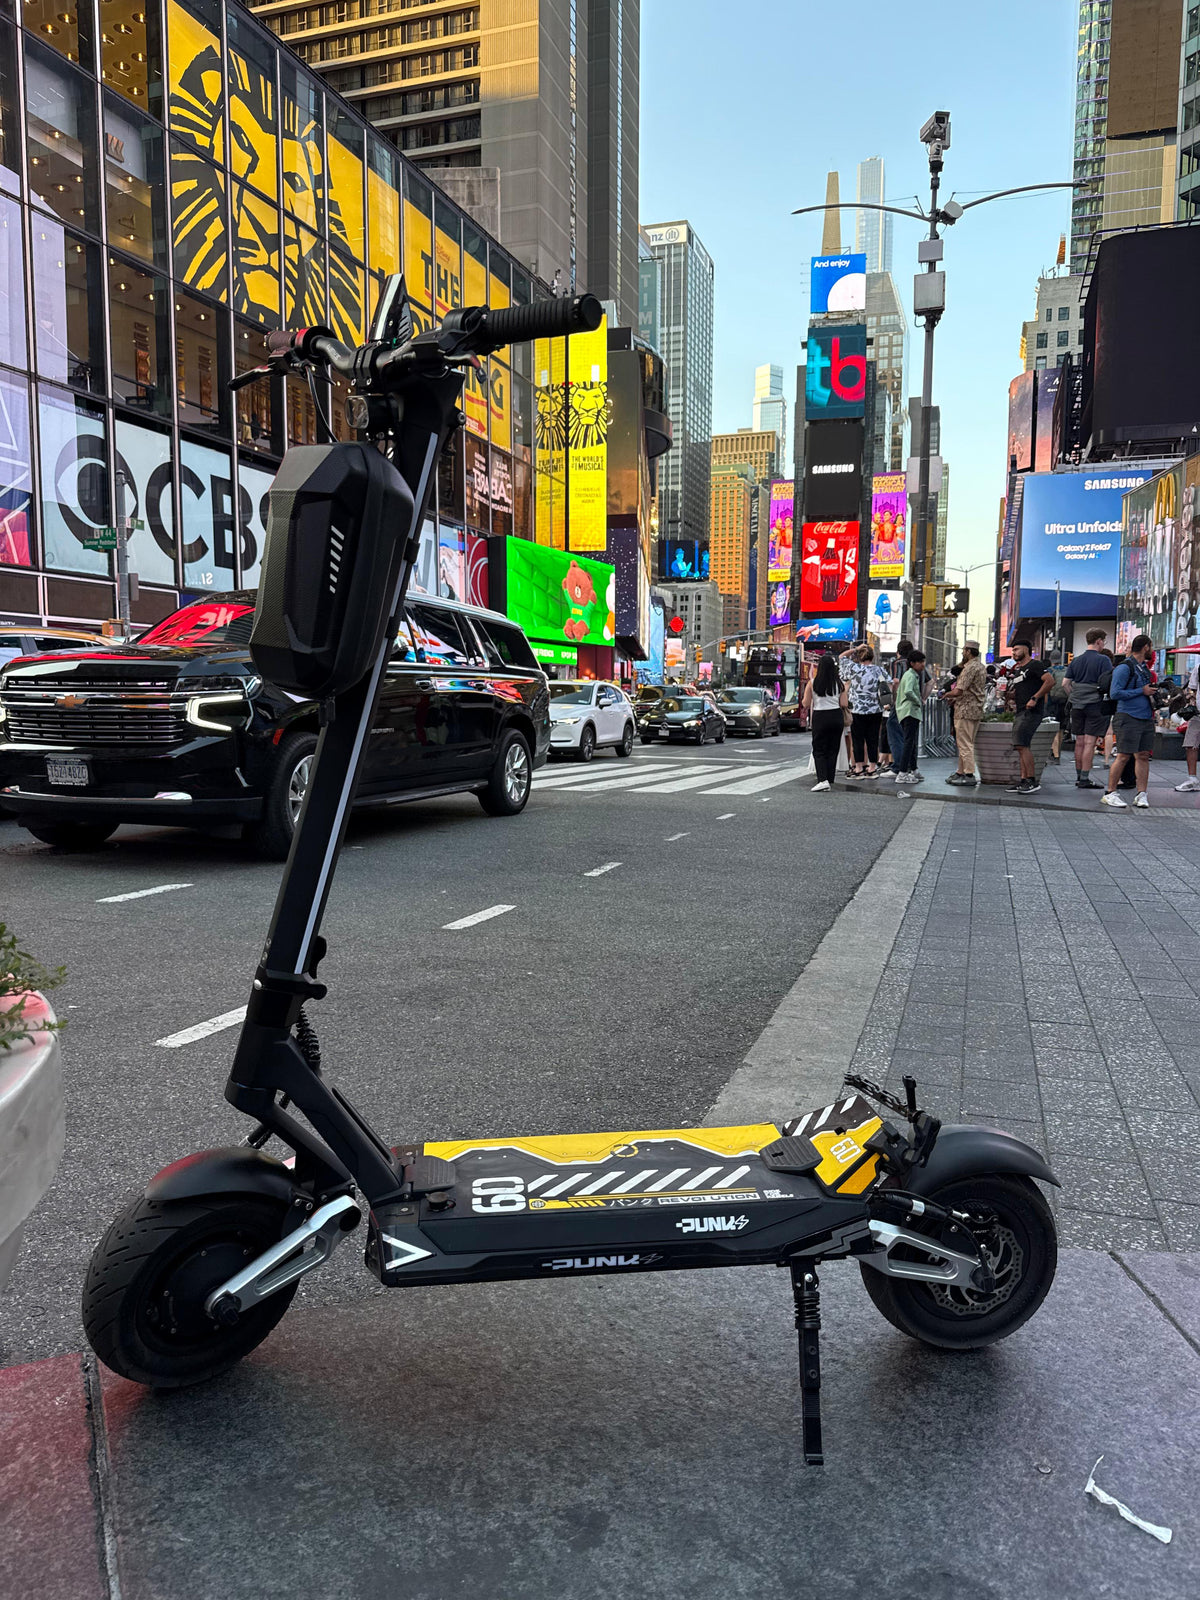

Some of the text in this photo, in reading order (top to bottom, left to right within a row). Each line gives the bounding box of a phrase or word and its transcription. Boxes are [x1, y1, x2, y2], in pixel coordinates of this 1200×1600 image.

[814, 259, 850, 268] And enjoy
[421, 250, 460, 308] THE
[578, 463, 603, 471] MUSICAL
[812, 463, 854, 474] SAMSUNG
[105, 529, 112, 537] 44
[1044, 524, 1075, 535] Ultra
[1057, 544, 1084, 553] Galaxy
[1091, 543, 1111, 551] Fold7
[1065, 553, 1088, 561] Galaxy
[830, 1137, 861, 1163] 60
[472, 1176, 526, 1213] 60
[660, 1193, 757, 1204] REVOLUTION
[610, 1198, 653, 1207] パンク
